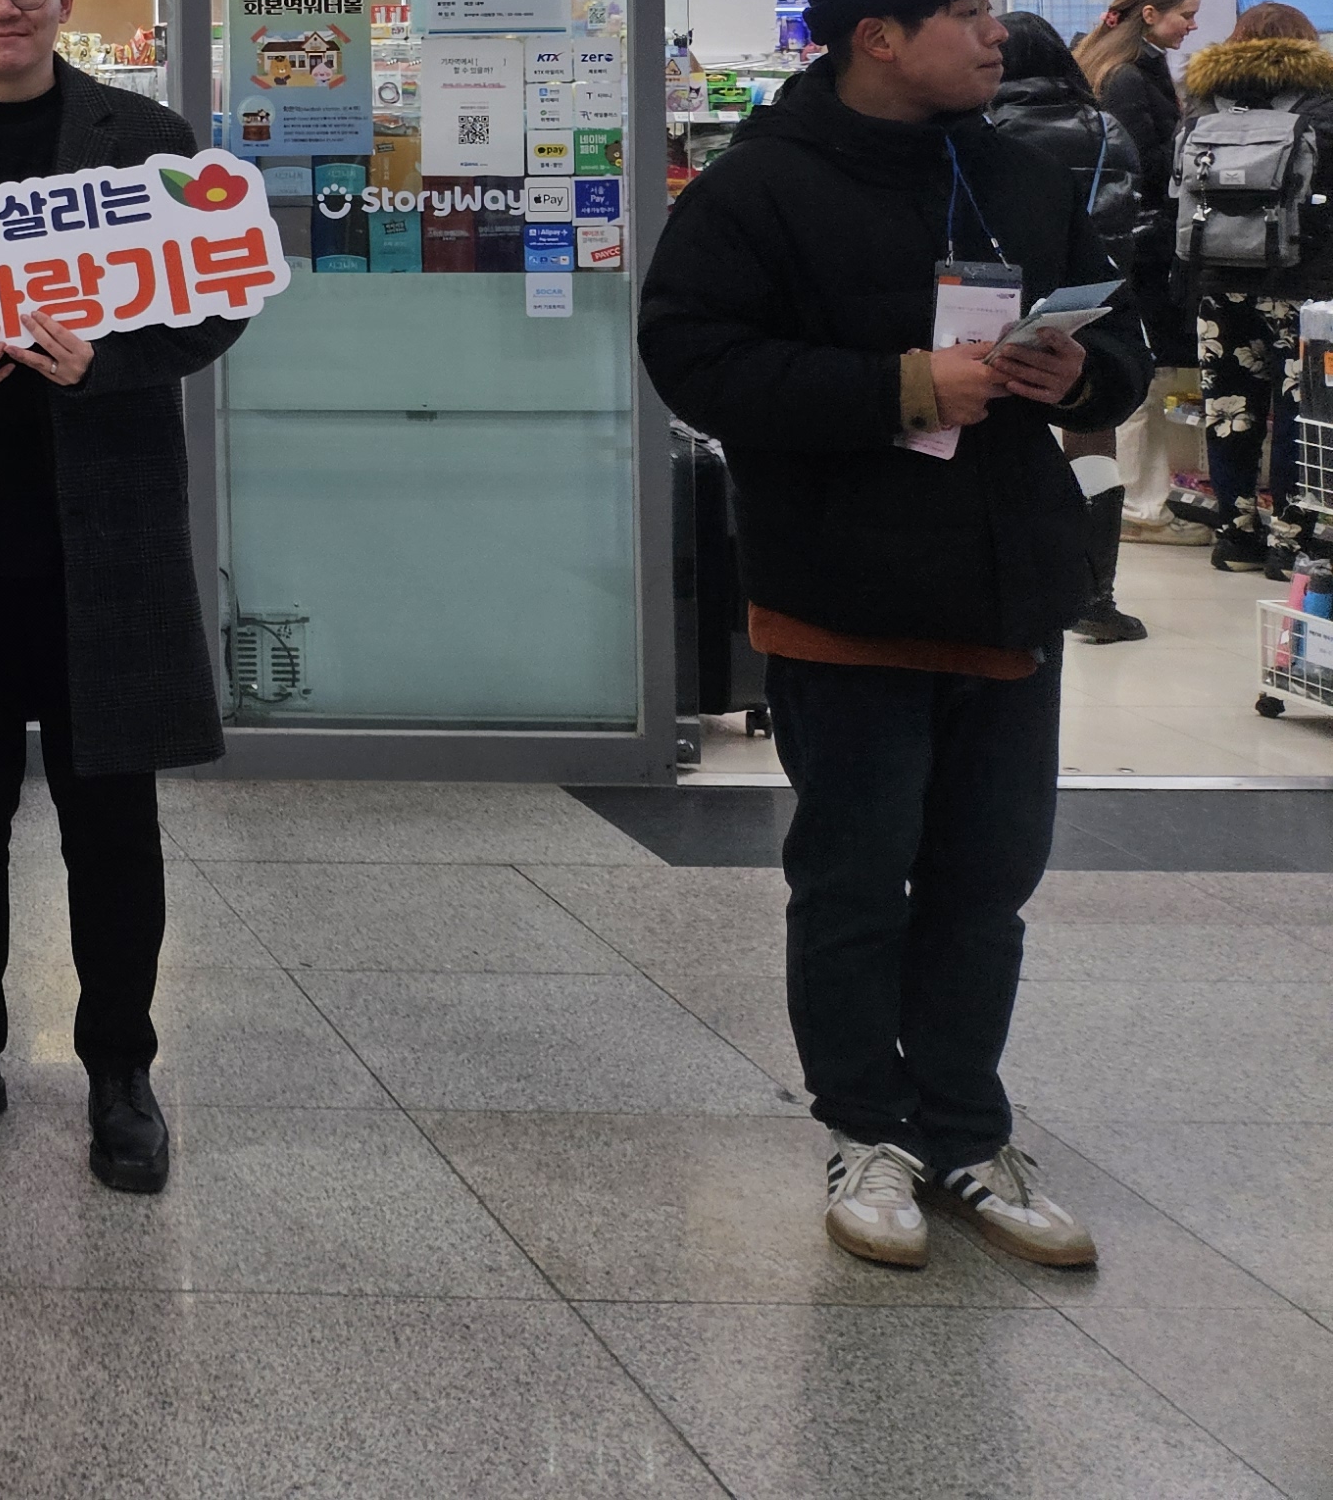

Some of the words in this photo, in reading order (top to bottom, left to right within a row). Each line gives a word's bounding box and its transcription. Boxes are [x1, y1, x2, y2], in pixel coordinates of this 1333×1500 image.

[537, 52, 564, 62] KTX
[581, 54, 614, 62] zero
[579, 134, 607, 144] 네이버
[546, 145, 564, 155] pay
[579, 145, 599, 155] 페이
[361, 186, 525, 216] StoryWay
[543, 195, 564, 204] Pay
[590, 195, 605, 203] Pay
